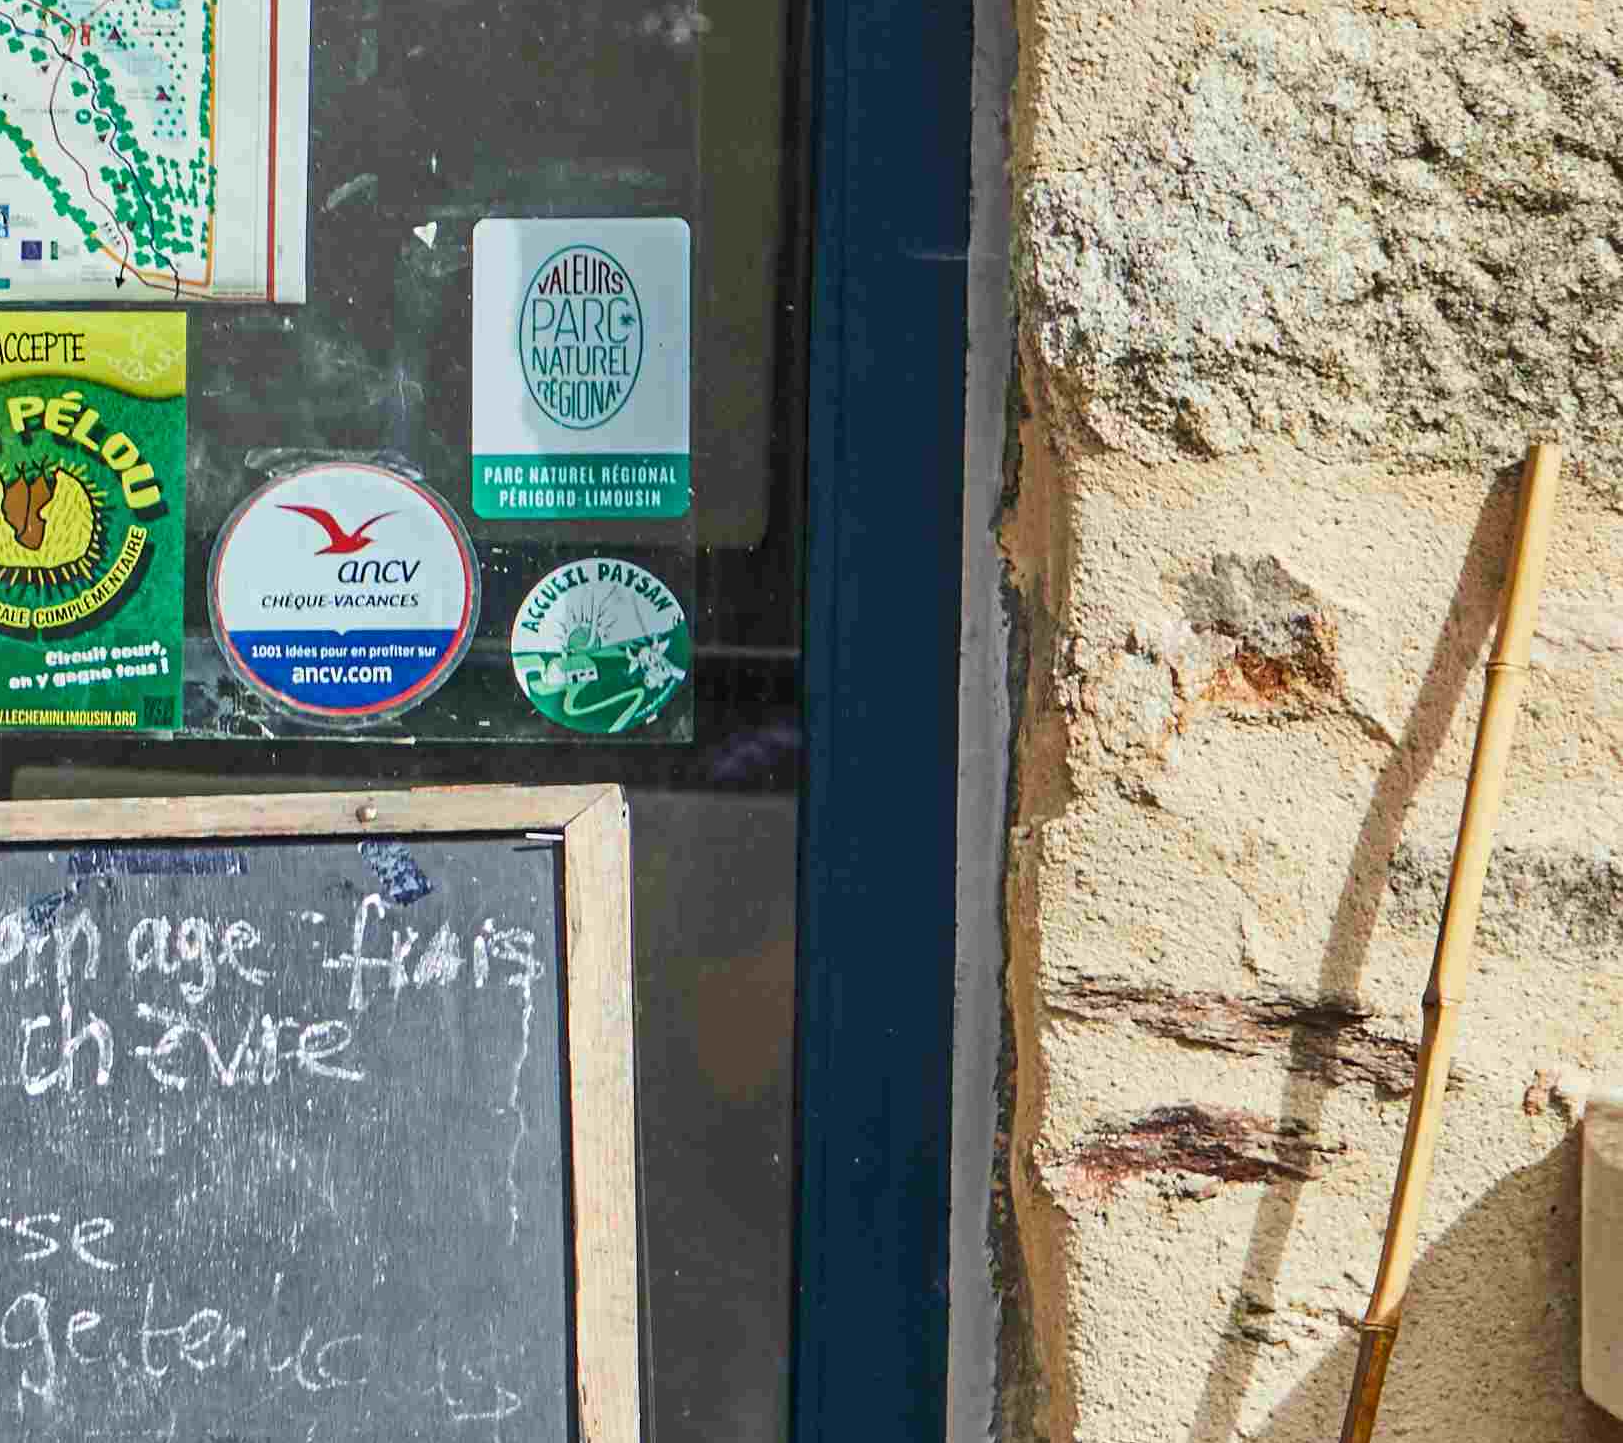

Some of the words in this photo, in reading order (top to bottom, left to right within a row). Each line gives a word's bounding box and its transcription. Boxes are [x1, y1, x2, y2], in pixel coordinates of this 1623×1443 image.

[531, 296, 631, 344] PARC
[531, 344, 631, 378] NATUREL
[536, 377, 625, 422] RÉGIONAL
[6, 389, 162, 509] PÉLOU
[484, 465, 525, 485] PARC
[529, 465, 596, 485] NATUREL
[601, 461, 677, 485] RÉGIONAL
[34, 527, 145, 627] COMPLÉMENTAIRE
[337, 559, 421, 585] ancv
[520, 566, 590, 634] ACCUEIL
[597, 562, 675, 613] PAYSAN
[251, 644, 282, 659] 1001
[285, 644, 318, 658] idées
[320, 647, 350, 661] pour
[351, 647, 367, 658] en
[368, 644, 416, 661] profiter
[417, 646, 438, 658] sur
[115, 663, 158, 680] tous
[291, 664, 393, 686] ancv.com
